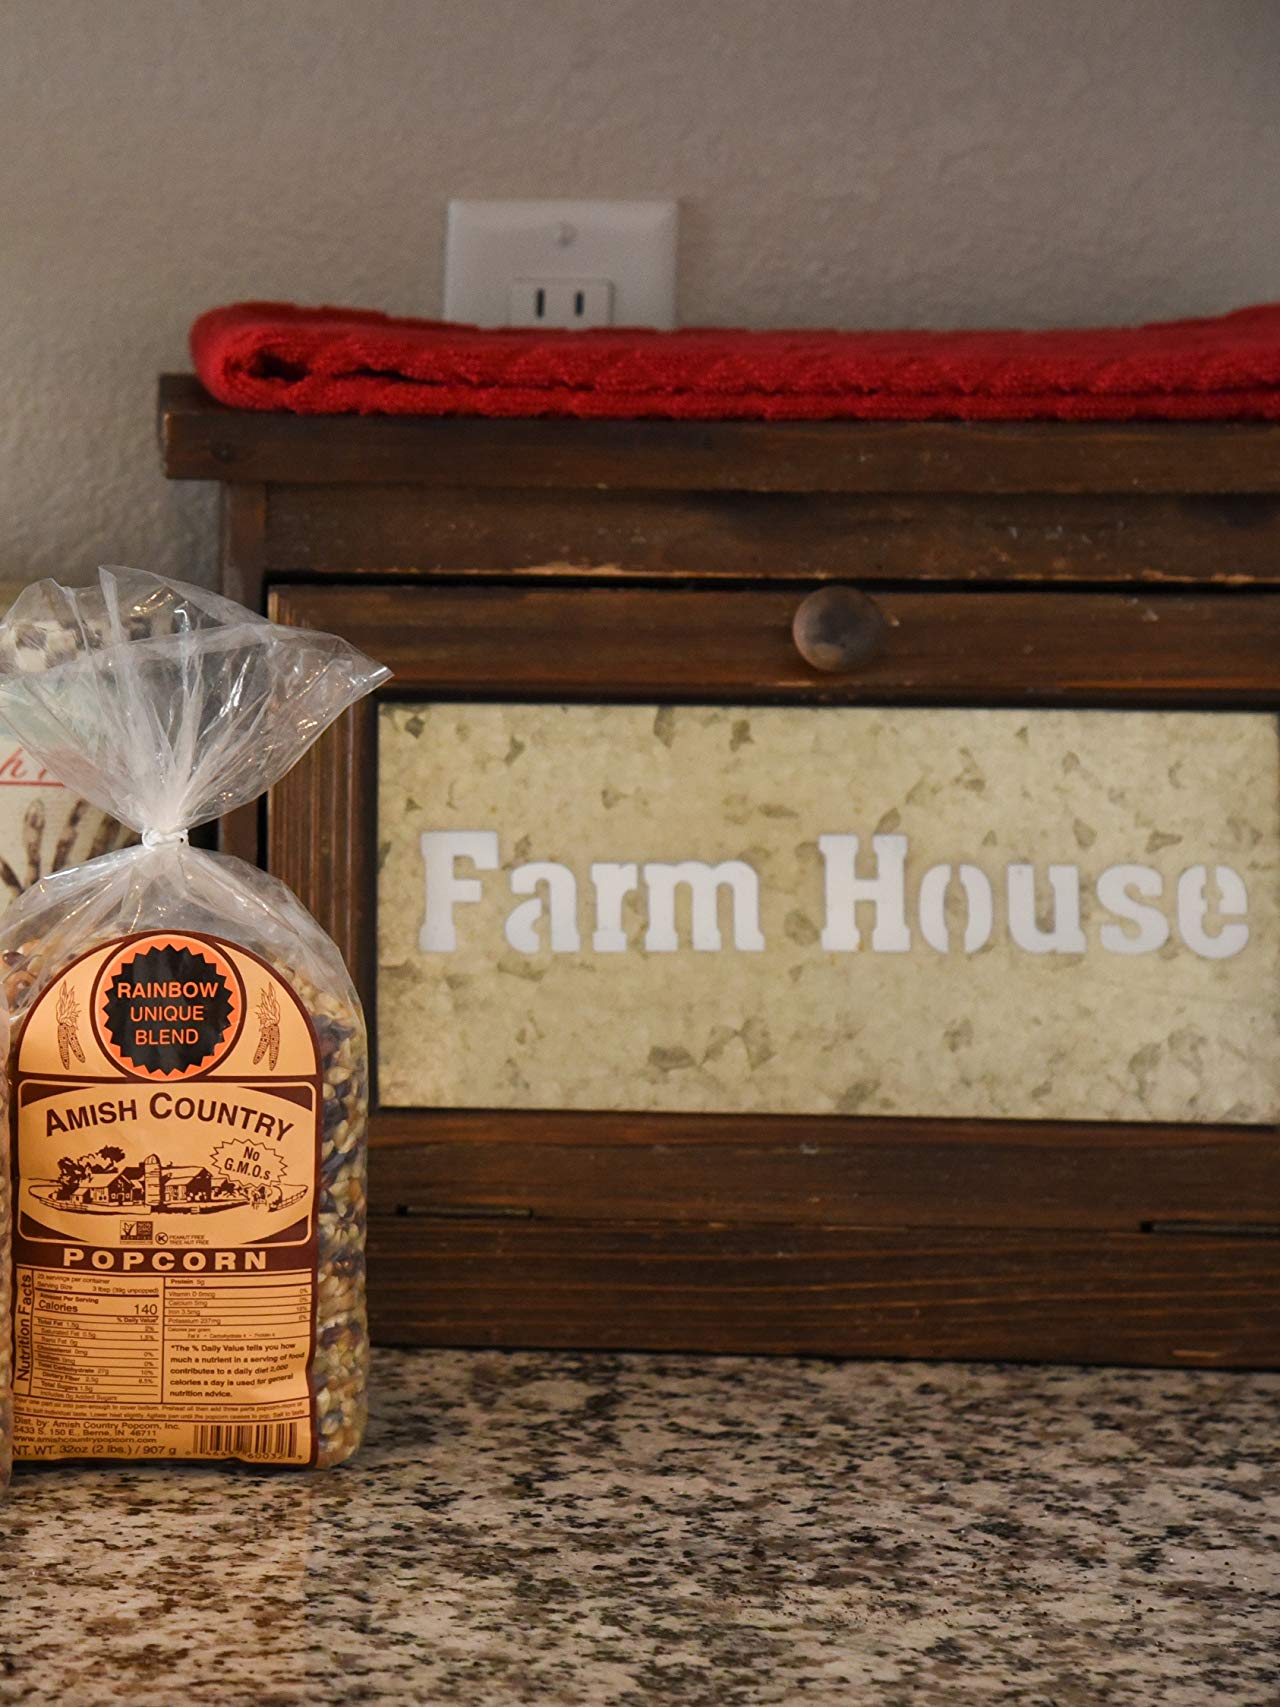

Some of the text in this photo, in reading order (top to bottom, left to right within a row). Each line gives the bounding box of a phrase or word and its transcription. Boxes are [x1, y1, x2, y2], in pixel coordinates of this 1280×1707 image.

[419, 830, 1251, 958] Farm House
[118, 982, 219, 998] RAINBOW
[130, 1006, 204, 1022] UNIQUE
[135, 1029, 199, 1045] BLEND
[63, 1248, 266, 1271] POPCORN
[39, 1300, 157, 1315] Calories 140
[17, 1274, 32, 1381] Nutrition Facts
[202, 1345, 220, 1353] Daily
[281, 1342, 295, 1350] how
[251, 1356, 278, 1365] serving
[234, 1368, 252, 1376] daily
[211, 1379, 224, 1387] day
[268, 1373, 293, 1384] general
[15, 1416, 32, 1424] Dist.
[53, 1420, 80, 1428] Amish
[84, 1422, 118, 1431] Country
[122, 1422, 161, 1430] Popcorn,
[15, 1425, 35, 1434] 5433
[38, 1427, 44, 1435] S.
[13, 1435, 156, 1443] www.amishcountrypopcorn.com
[12, 1445, 32, 1456] NT.
[34, 1446, 56, 1455] WT.
[60, 1446, 88, 1454] 32oz
[92, 1445, 104, 1455] (2
[107, 1445, 132, 1455] lbs.)
[143, 1446, 165, 1454] 907
